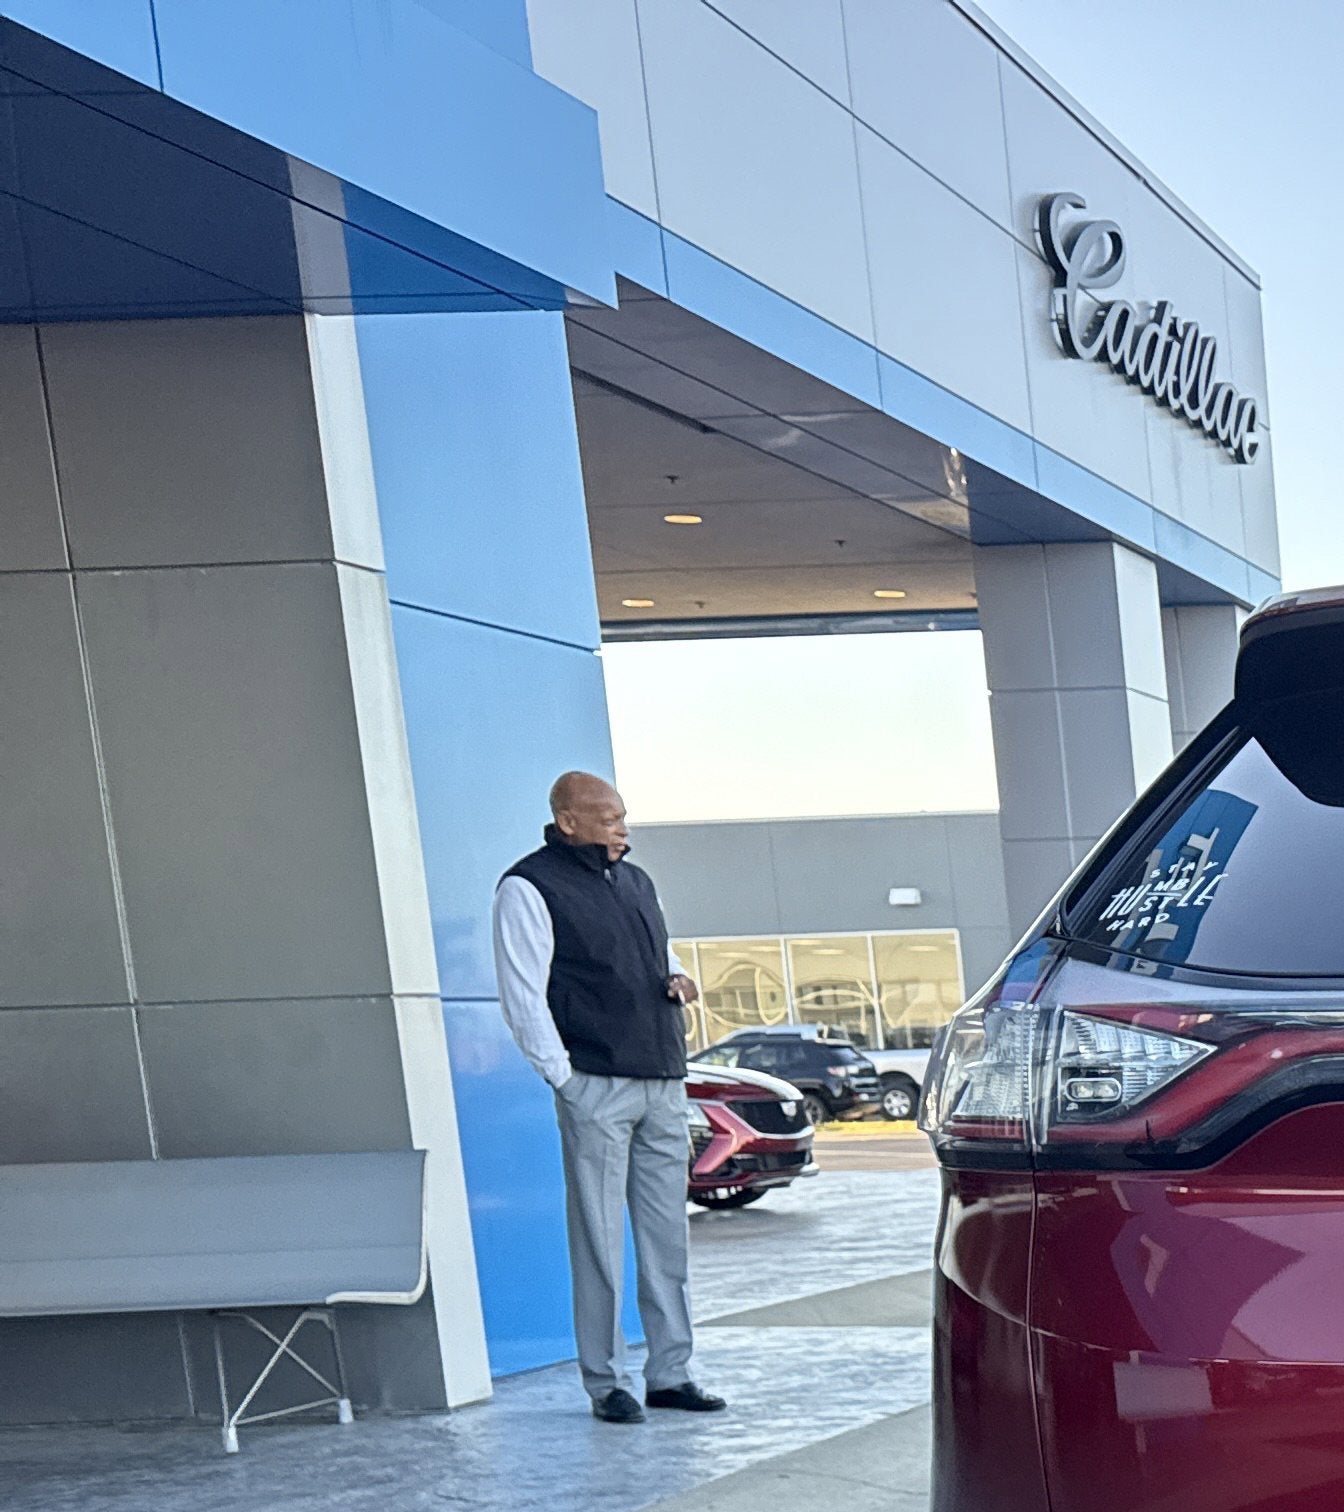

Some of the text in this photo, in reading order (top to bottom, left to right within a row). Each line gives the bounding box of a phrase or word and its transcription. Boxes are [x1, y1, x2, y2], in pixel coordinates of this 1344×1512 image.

[1036, 192, 1258, 464] Cadillac
[1150, 861, 1219, 878] STAY
[1106, 913, 1170, 931] HARD
